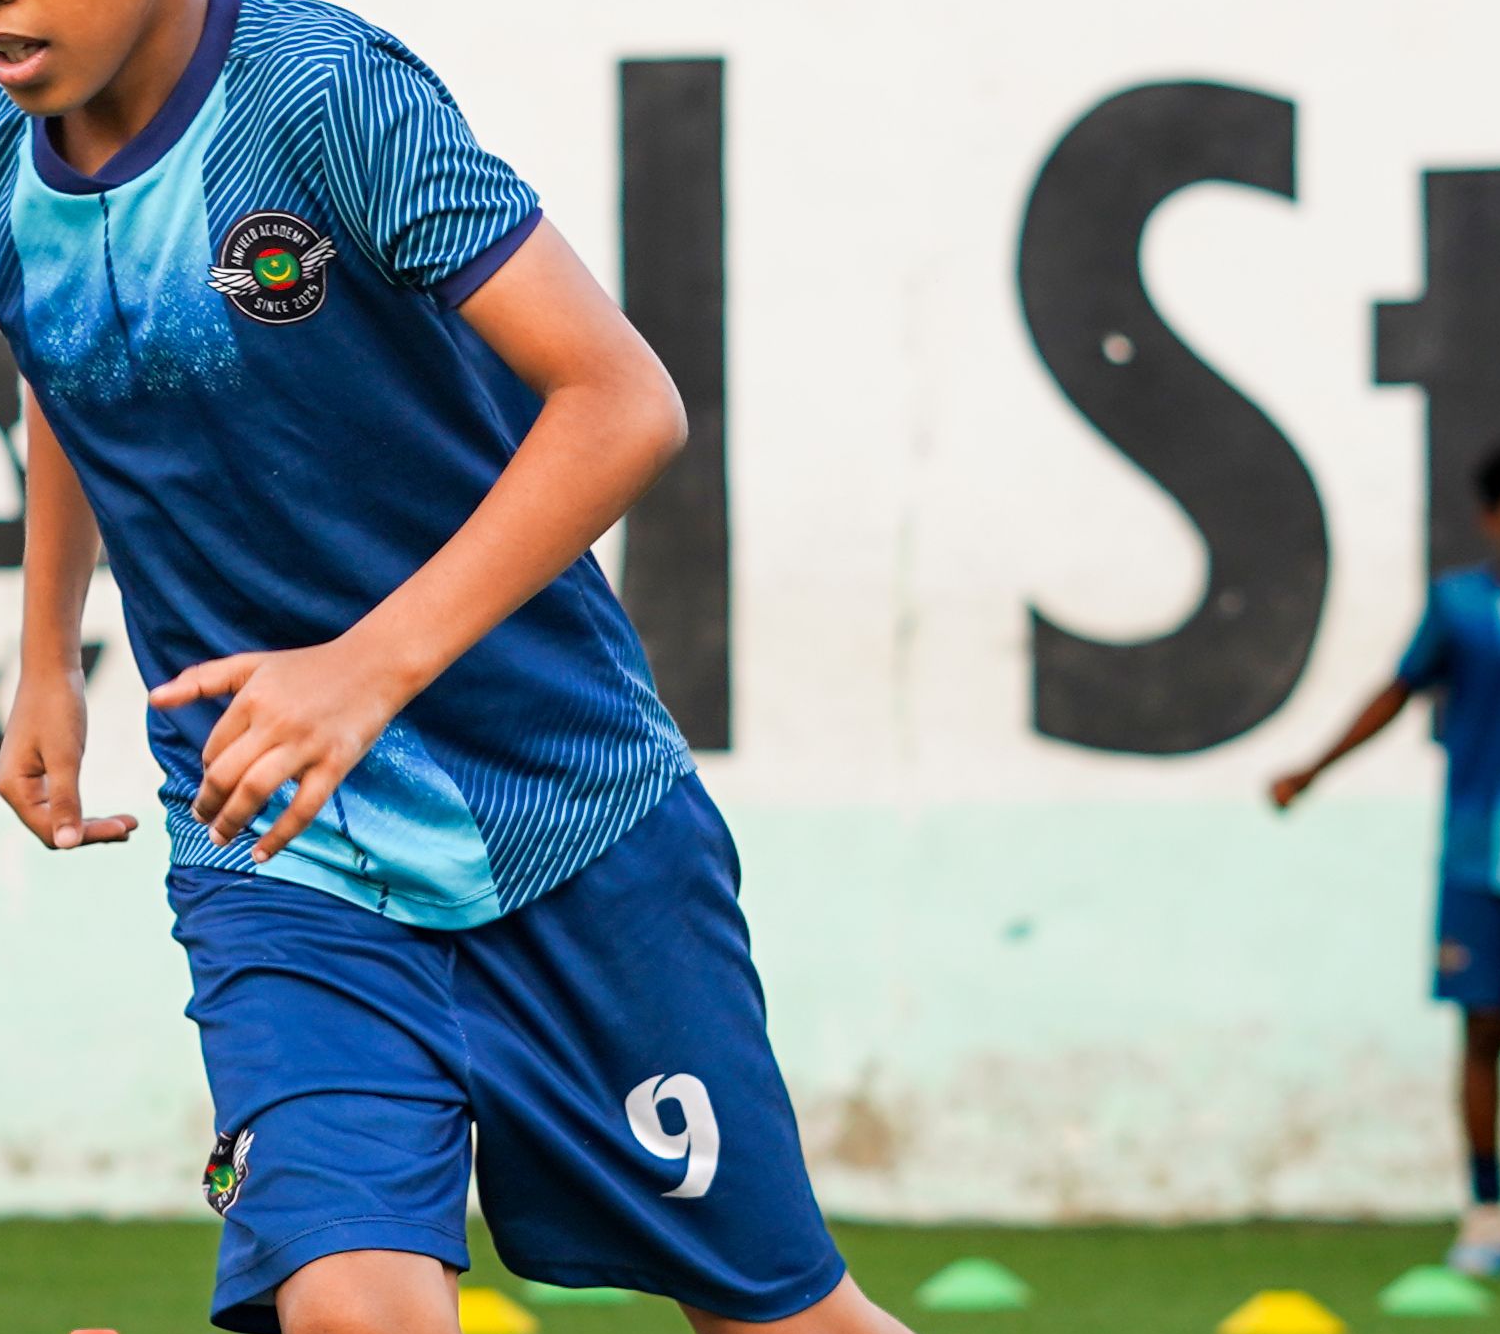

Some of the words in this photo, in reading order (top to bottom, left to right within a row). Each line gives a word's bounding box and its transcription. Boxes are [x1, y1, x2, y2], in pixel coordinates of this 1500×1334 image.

[230, 228, 259, 267] ANFIELD
[259, 223, 309, 247] ACADEMY
[254, 297, 289, 313] SINCE
[292, 283, 320, 310] 2025
[624, 1072, 721, 1200] 9
